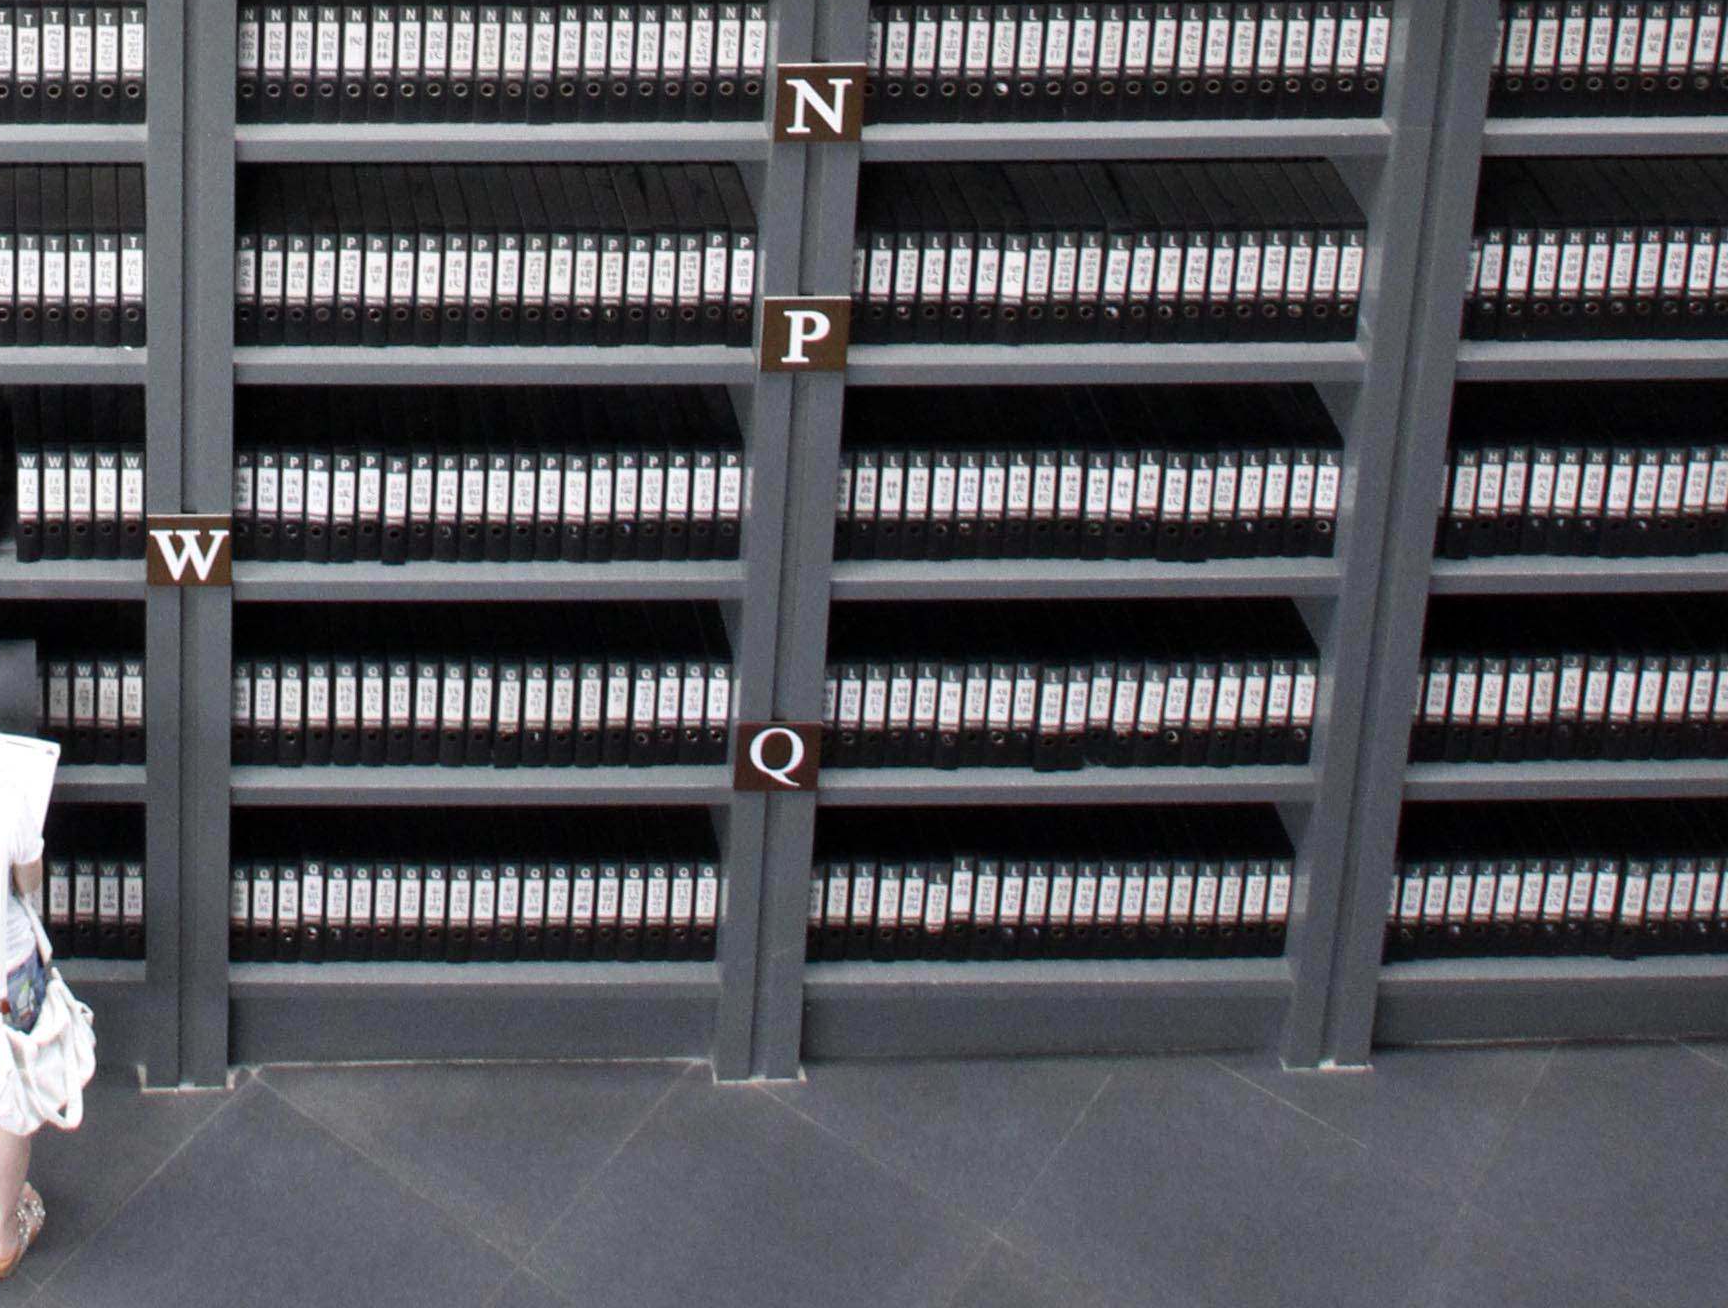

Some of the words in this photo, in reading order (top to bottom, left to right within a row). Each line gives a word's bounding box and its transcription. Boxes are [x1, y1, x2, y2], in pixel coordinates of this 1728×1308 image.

[324, 9, 334, 22] N
[1056, 7, 1064, 20] L
[1571, 5, 1581, 17] H
[786, 79, 852, 133] N
[506, 237, 515, 250] P
[1038, 237, 1047, 249] L
[1570, 232, 1581, 243] H
[781, 311, 830, 362] P
[495, 458, 505, 470] P
[916, 456, 924, 468] L
[1646, 453, 1657, 464] H
[149, 530, 227, 580] W
[103, 666, 117, 678] W
[666, 666, 677, 678] Q
[750, 728, 803, 786] Q
[127, 866, 140, 877] W
[308, 864, 319, 875] Q
